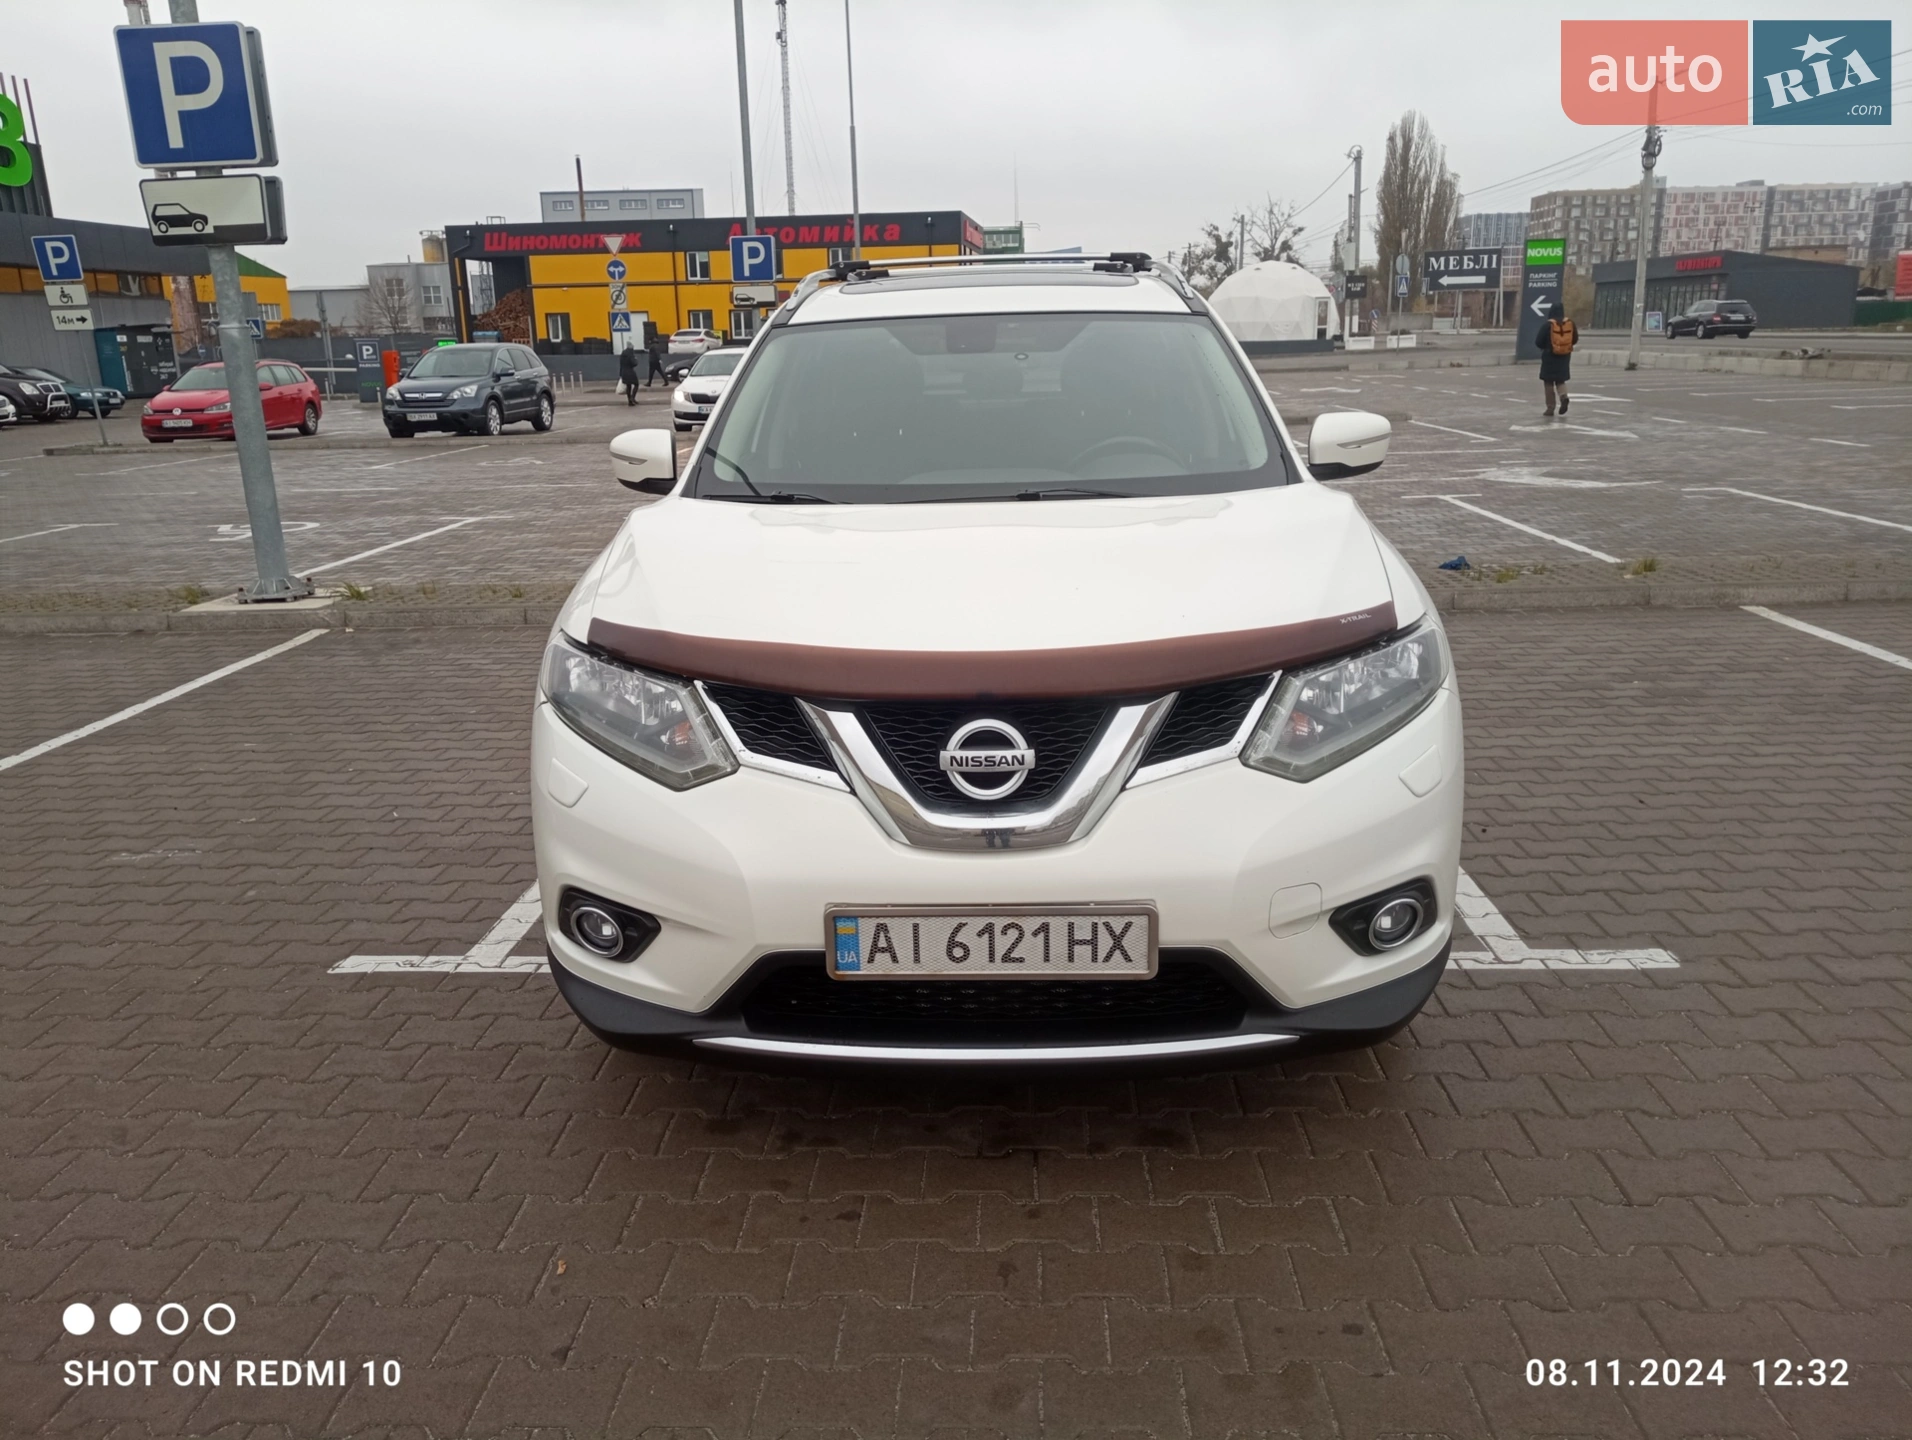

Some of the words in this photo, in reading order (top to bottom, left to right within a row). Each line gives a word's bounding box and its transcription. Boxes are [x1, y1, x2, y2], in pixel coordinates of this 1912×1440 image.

[152, 40, 224, 149] P
[484, 231, 643, 252] Шиномонтж
[44, 241, 70, 276] P
[742, 241, 766, 277] P
[1527, 247, 1563, 257] NOVUS
[1428, 254, 1498, 272] МЕБЛІ
[362, 345, 373, 360] P
[1340, 613, 1372, 624] X-TRAIL
[949, 754, 1025, 768] NISSAN
[866, 922, 921, 964] AI
[946, 921, 1050, 964] 6121
[1067, 921, 1134, 963] HX
[837, 951, 858, 964] UA
